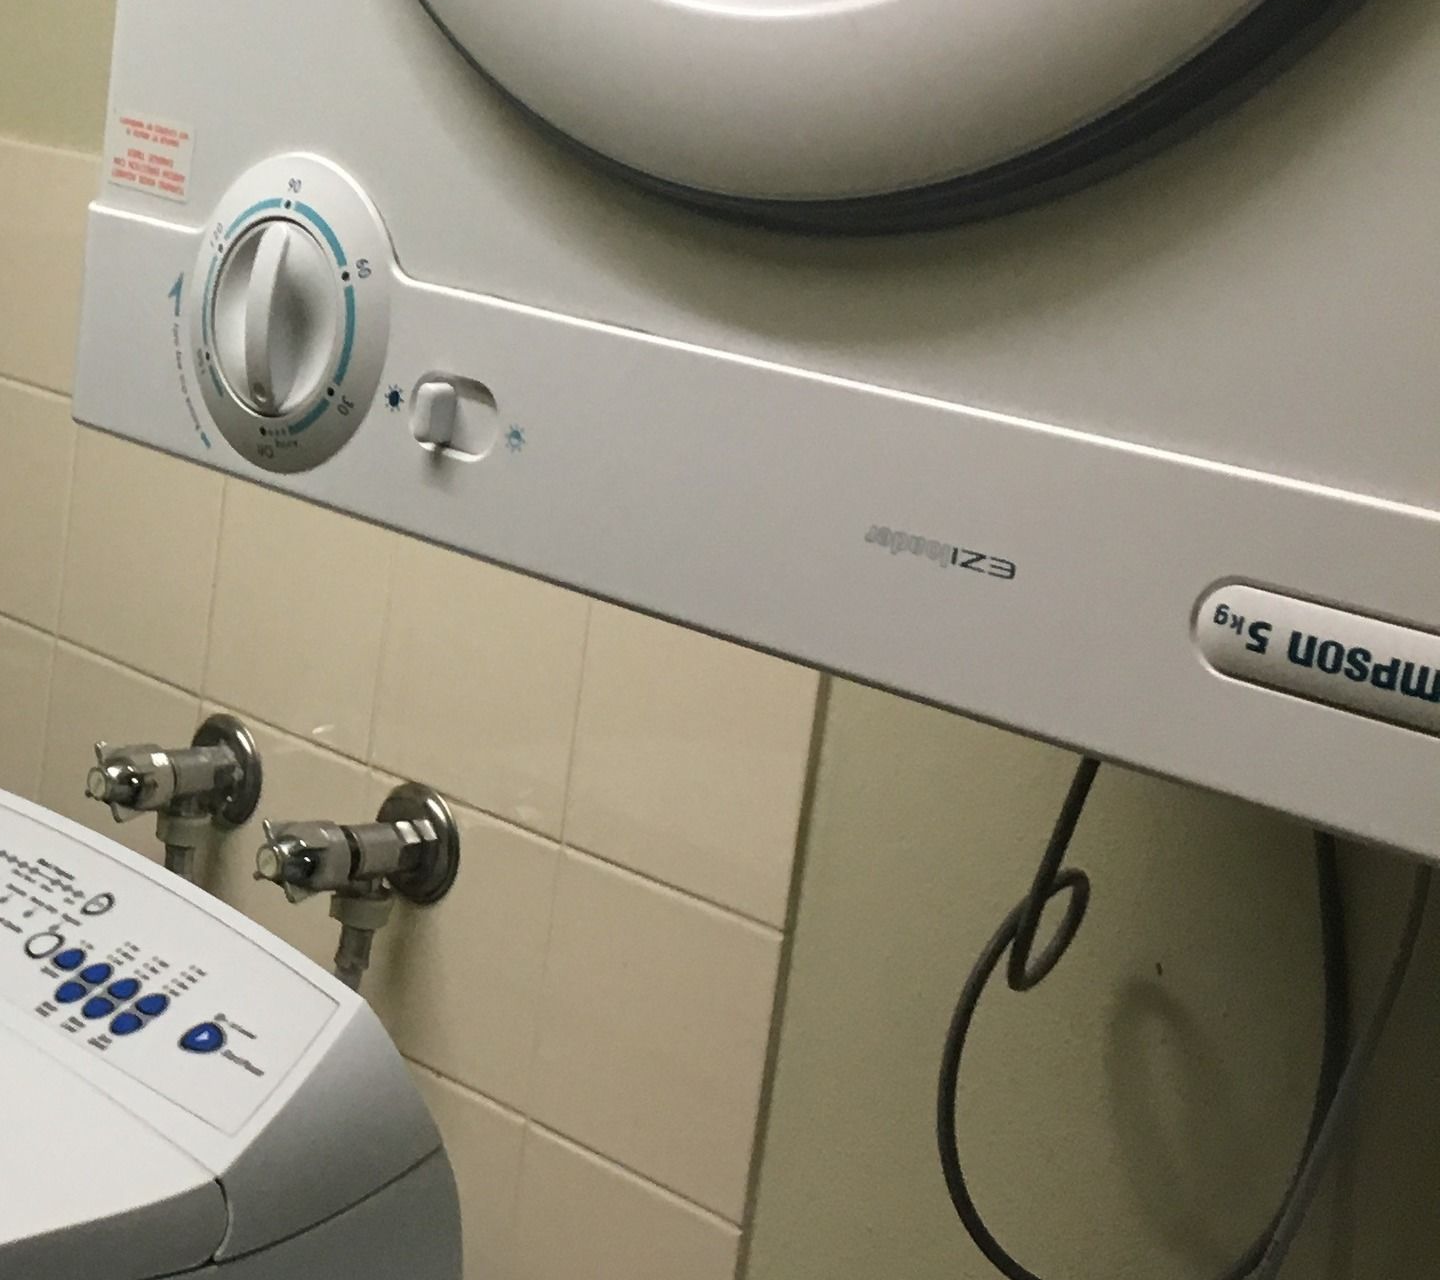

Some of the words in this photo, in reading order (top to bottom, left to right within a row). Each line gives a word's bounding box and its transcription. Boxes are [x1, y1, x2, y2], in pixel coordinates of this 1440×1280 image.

[287, 177, 302, 194] 90
[355, 258, 372, 280] 60
[336, 394, 355, 417] 30
